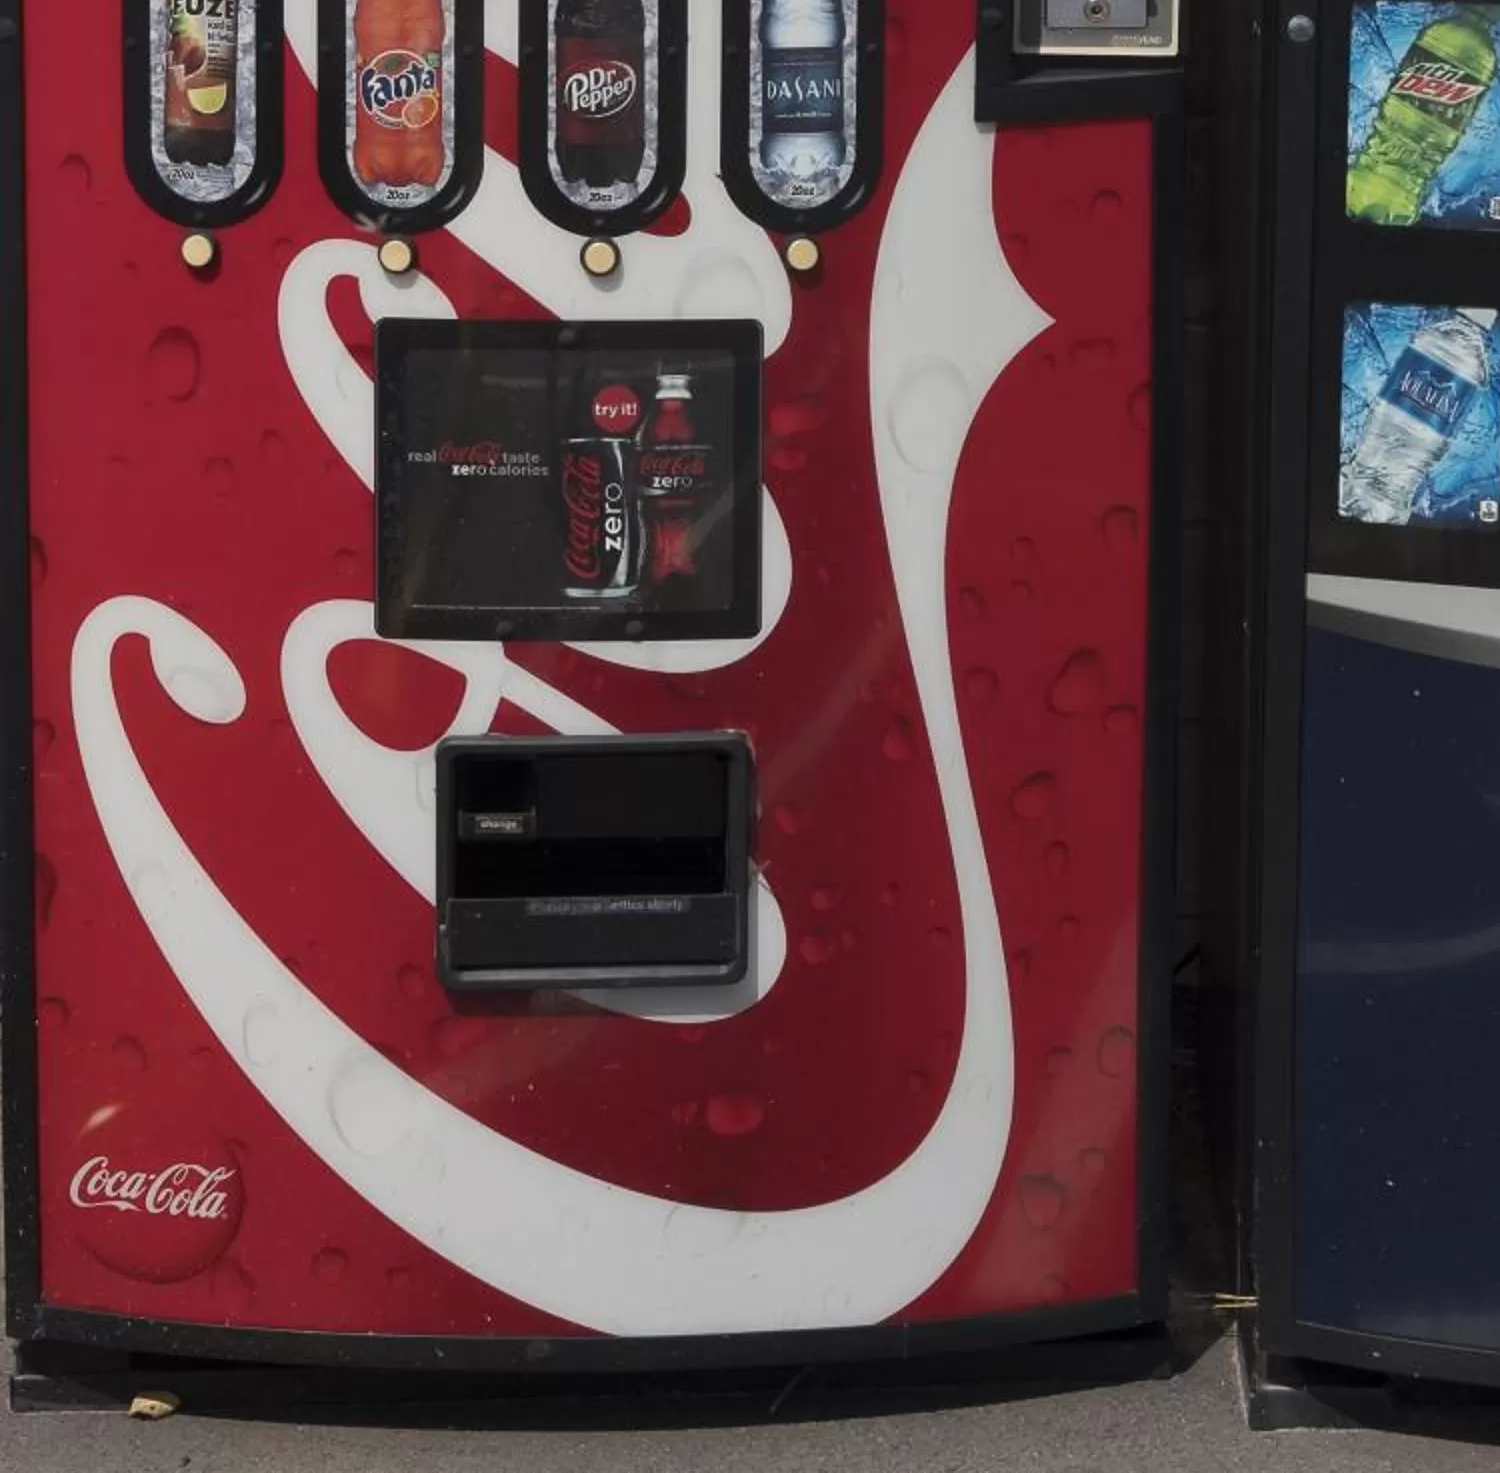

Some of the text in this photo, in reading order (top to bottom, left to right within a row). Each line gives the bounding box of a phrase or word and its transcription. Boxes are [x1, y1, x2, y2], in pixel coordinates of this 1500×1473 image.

[361, 60, 435, 112] Fanta
[589, 65, 617, 92] Dr
[767, 78, 841, 101] DASANI
[567, 76, 633, 113] Pepper
[594, 403, 619, 419] try
[407, 449, 437, 464] real
[503, 451, 541, 464] taste
[451, 463, 549, 476] zero calories
[652, 475, 694, 489] zero
[605, 481, 624, 551] zero
[69, 1156, 239, 1219] Coca-Cola
